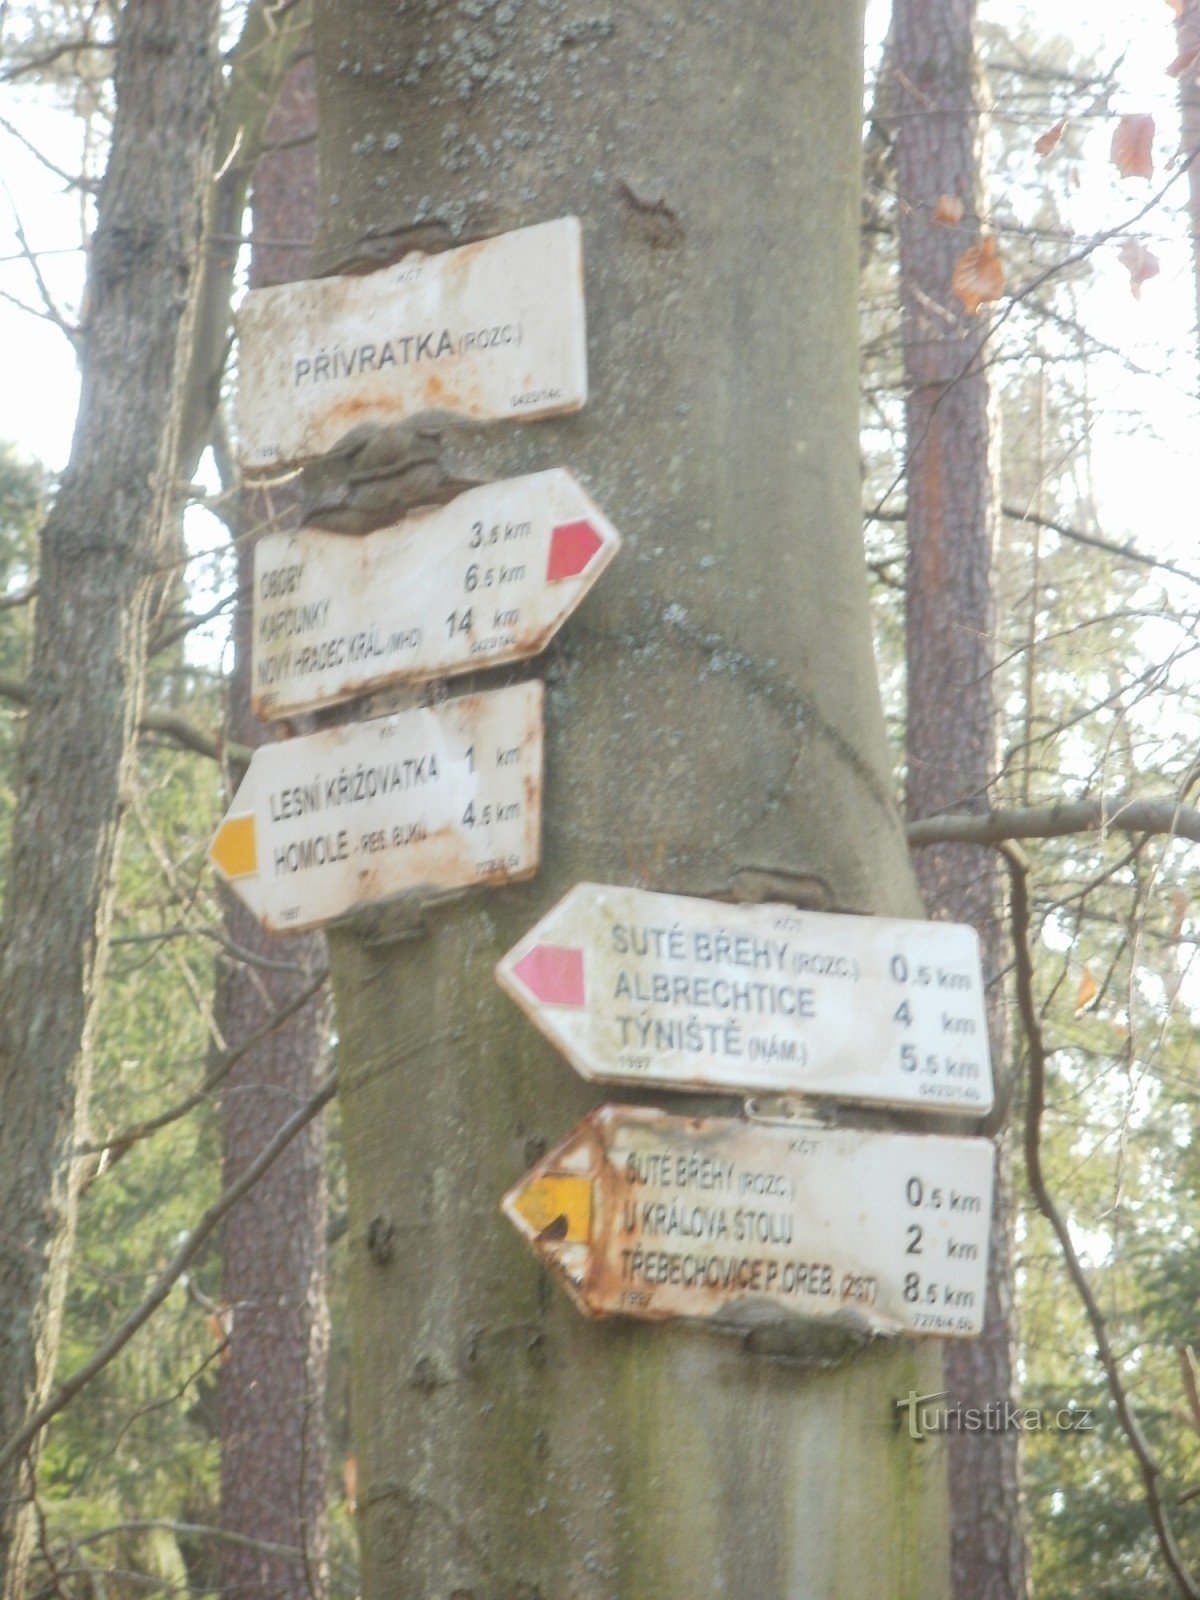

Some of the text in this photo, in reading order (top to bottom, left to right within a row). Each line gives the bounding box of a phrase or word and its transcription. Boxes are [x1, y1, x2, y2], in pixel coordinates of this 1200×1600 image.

[294, 328, 452, 386] PŘÍVRATKA
[503, 519, 532, 539] km
[498, 562, 527, 584] km
[445, 606, 473, 639] 14
[492, 607, 521, 629] km
[270, 744, 521, 822] LESNÍ KŘIŽOVATKA 1 km
[274, 829, 349, 877] HOMOLE
[495, 801, 521, 822] km
[611, 922, 686, 959] SUTÉ
[693, 928, 789, 970] BŘEHY
[792, 952, 860, 983] (ROZC.)
[937, 967, 972, 992] km
[614, 971, 976, 1036] ALBRECHTICE 4 km
[616, 1009, 743, 1056] TÝNIŠTĚ
[749, 1033, 808, 1068] (NÁM.)
[945, 1055, 980, 1081] km
[626, 1146, 672, 1187] SUTÉ
[675, 1150, 735, 1191] BŘEHY
[950, 1188, 982, 1214] km
[624, 1200, 638, 1233] U
[642, 1195, 729, 1240] KRÁLOVA
[906, 1223, 923, 1255] 2
[947, 1237, 979, 1261] km
[621, 1244, 762, 1292] TŘEBECHOVICE
[944, 1283, 976, 1309] km
